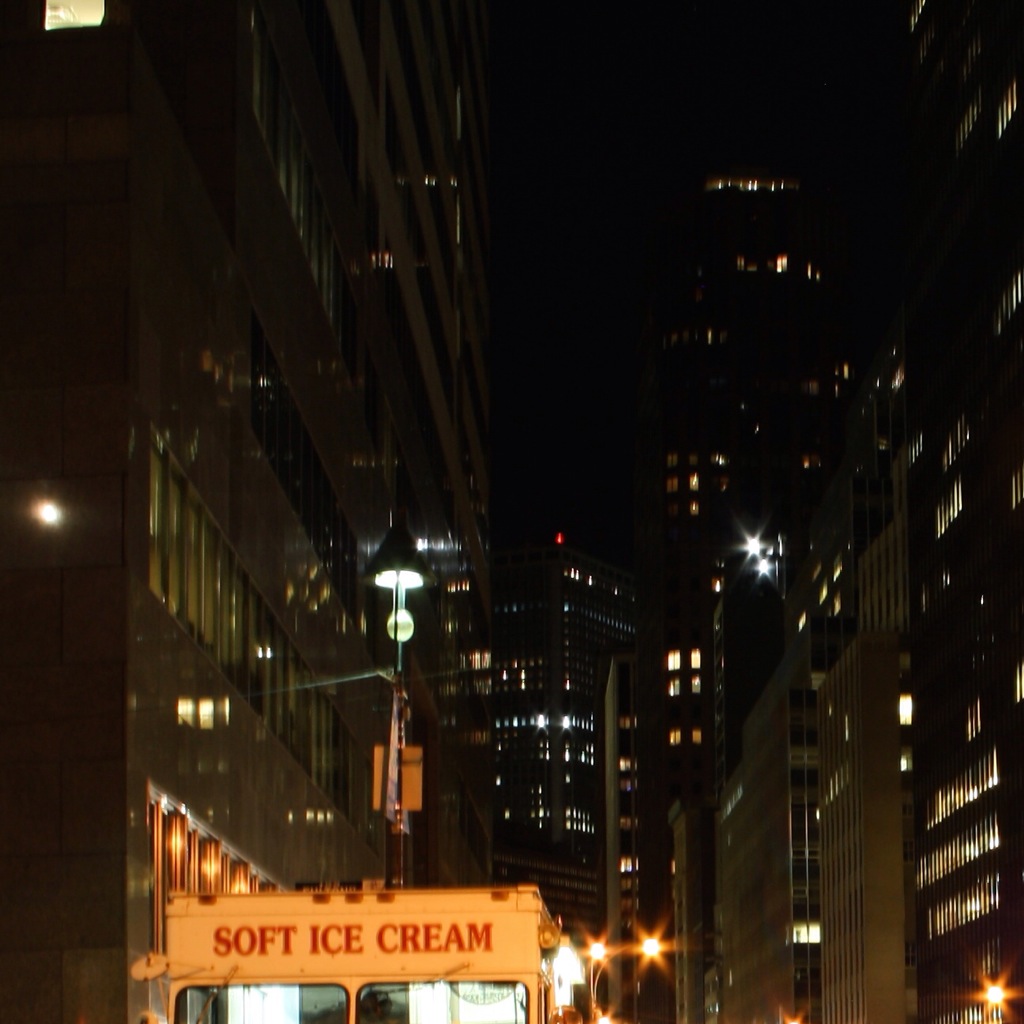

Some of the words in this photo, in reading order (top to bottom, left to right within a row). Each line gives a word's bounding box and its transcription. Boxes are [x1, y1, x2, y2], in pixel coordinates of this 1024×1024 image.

[213, 925, 297, 956] SOFT
[309, 924, 363, 955] ICE
[375, 923, 493, 953] CREAM
